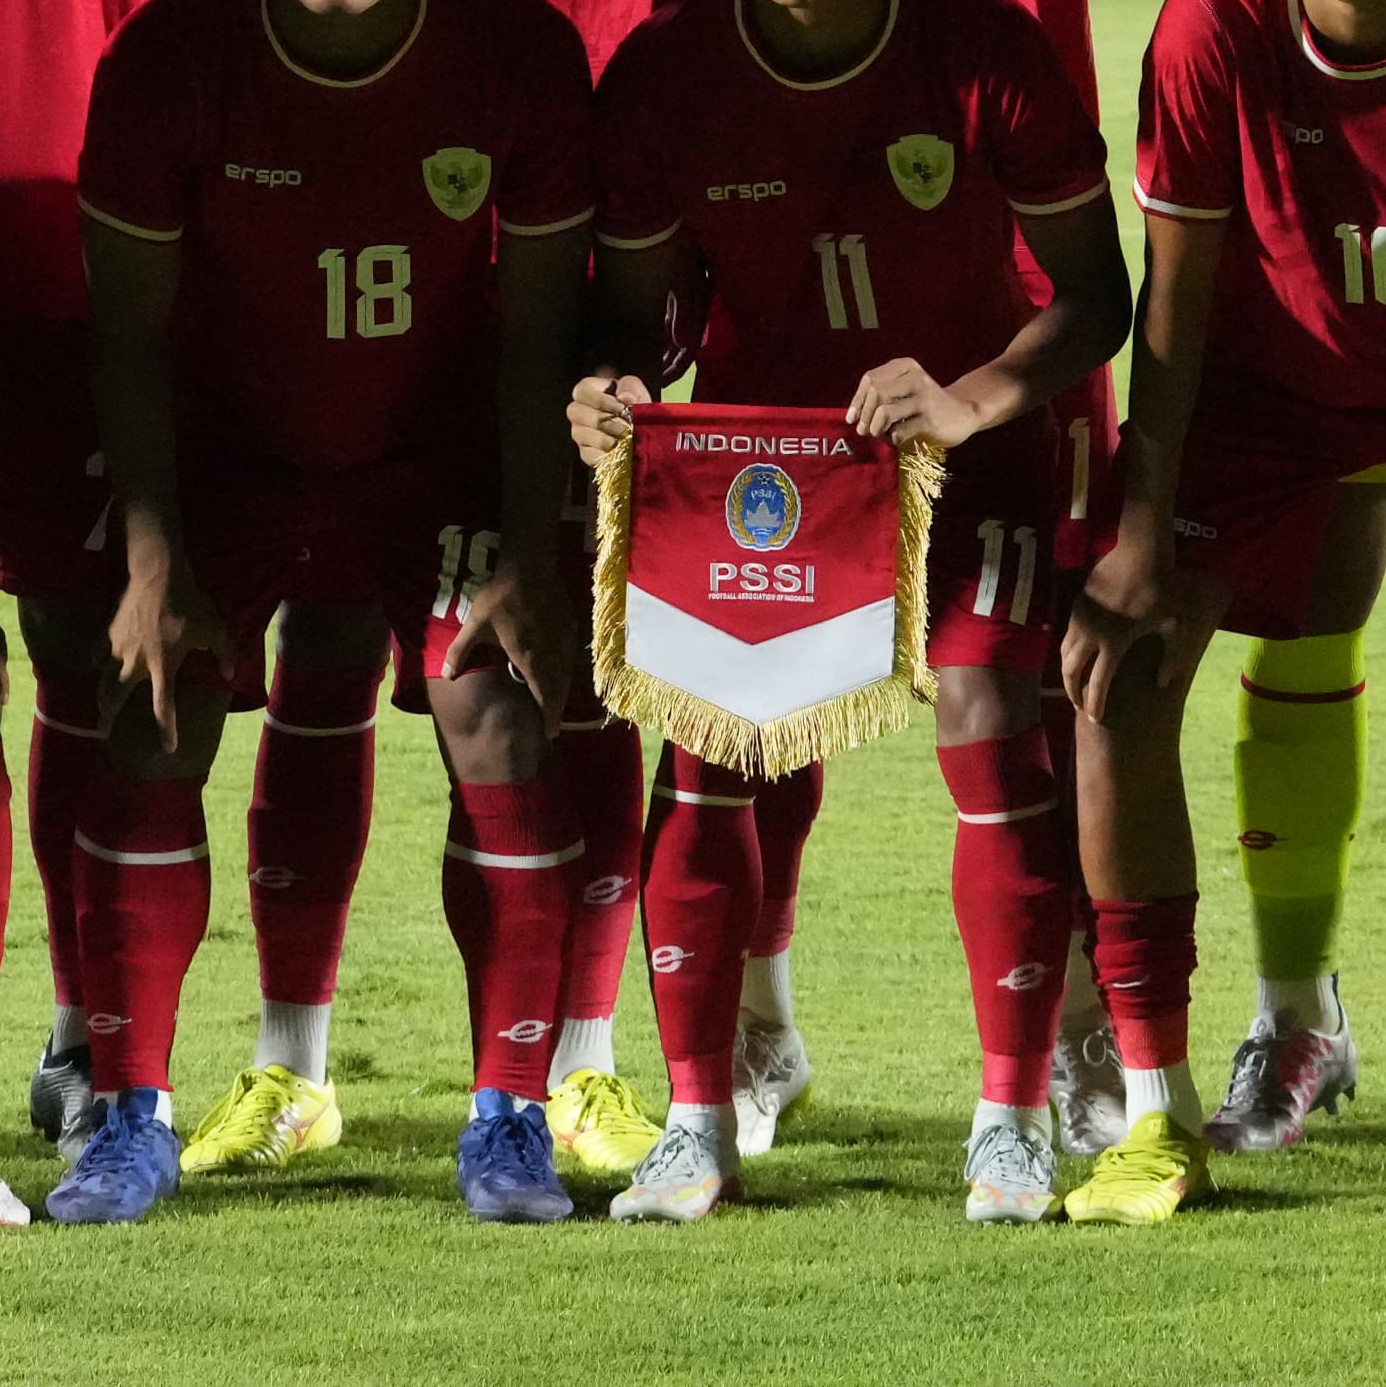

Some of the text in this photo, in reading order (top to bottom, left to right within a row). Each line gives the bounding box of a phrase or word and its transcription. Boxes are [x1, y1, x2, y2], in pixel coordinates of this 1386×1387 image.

[225, 163, 302, 188] erspo
[707, 180, 786, 202] erspo
[318, 244, 412, 339] 18
[813, 232, 879, 329] 11
[675, 431, 854, 457] INDONESIA
[709, 562, 815, 594] PSSI
[972, 518, 1037, 625] 11
